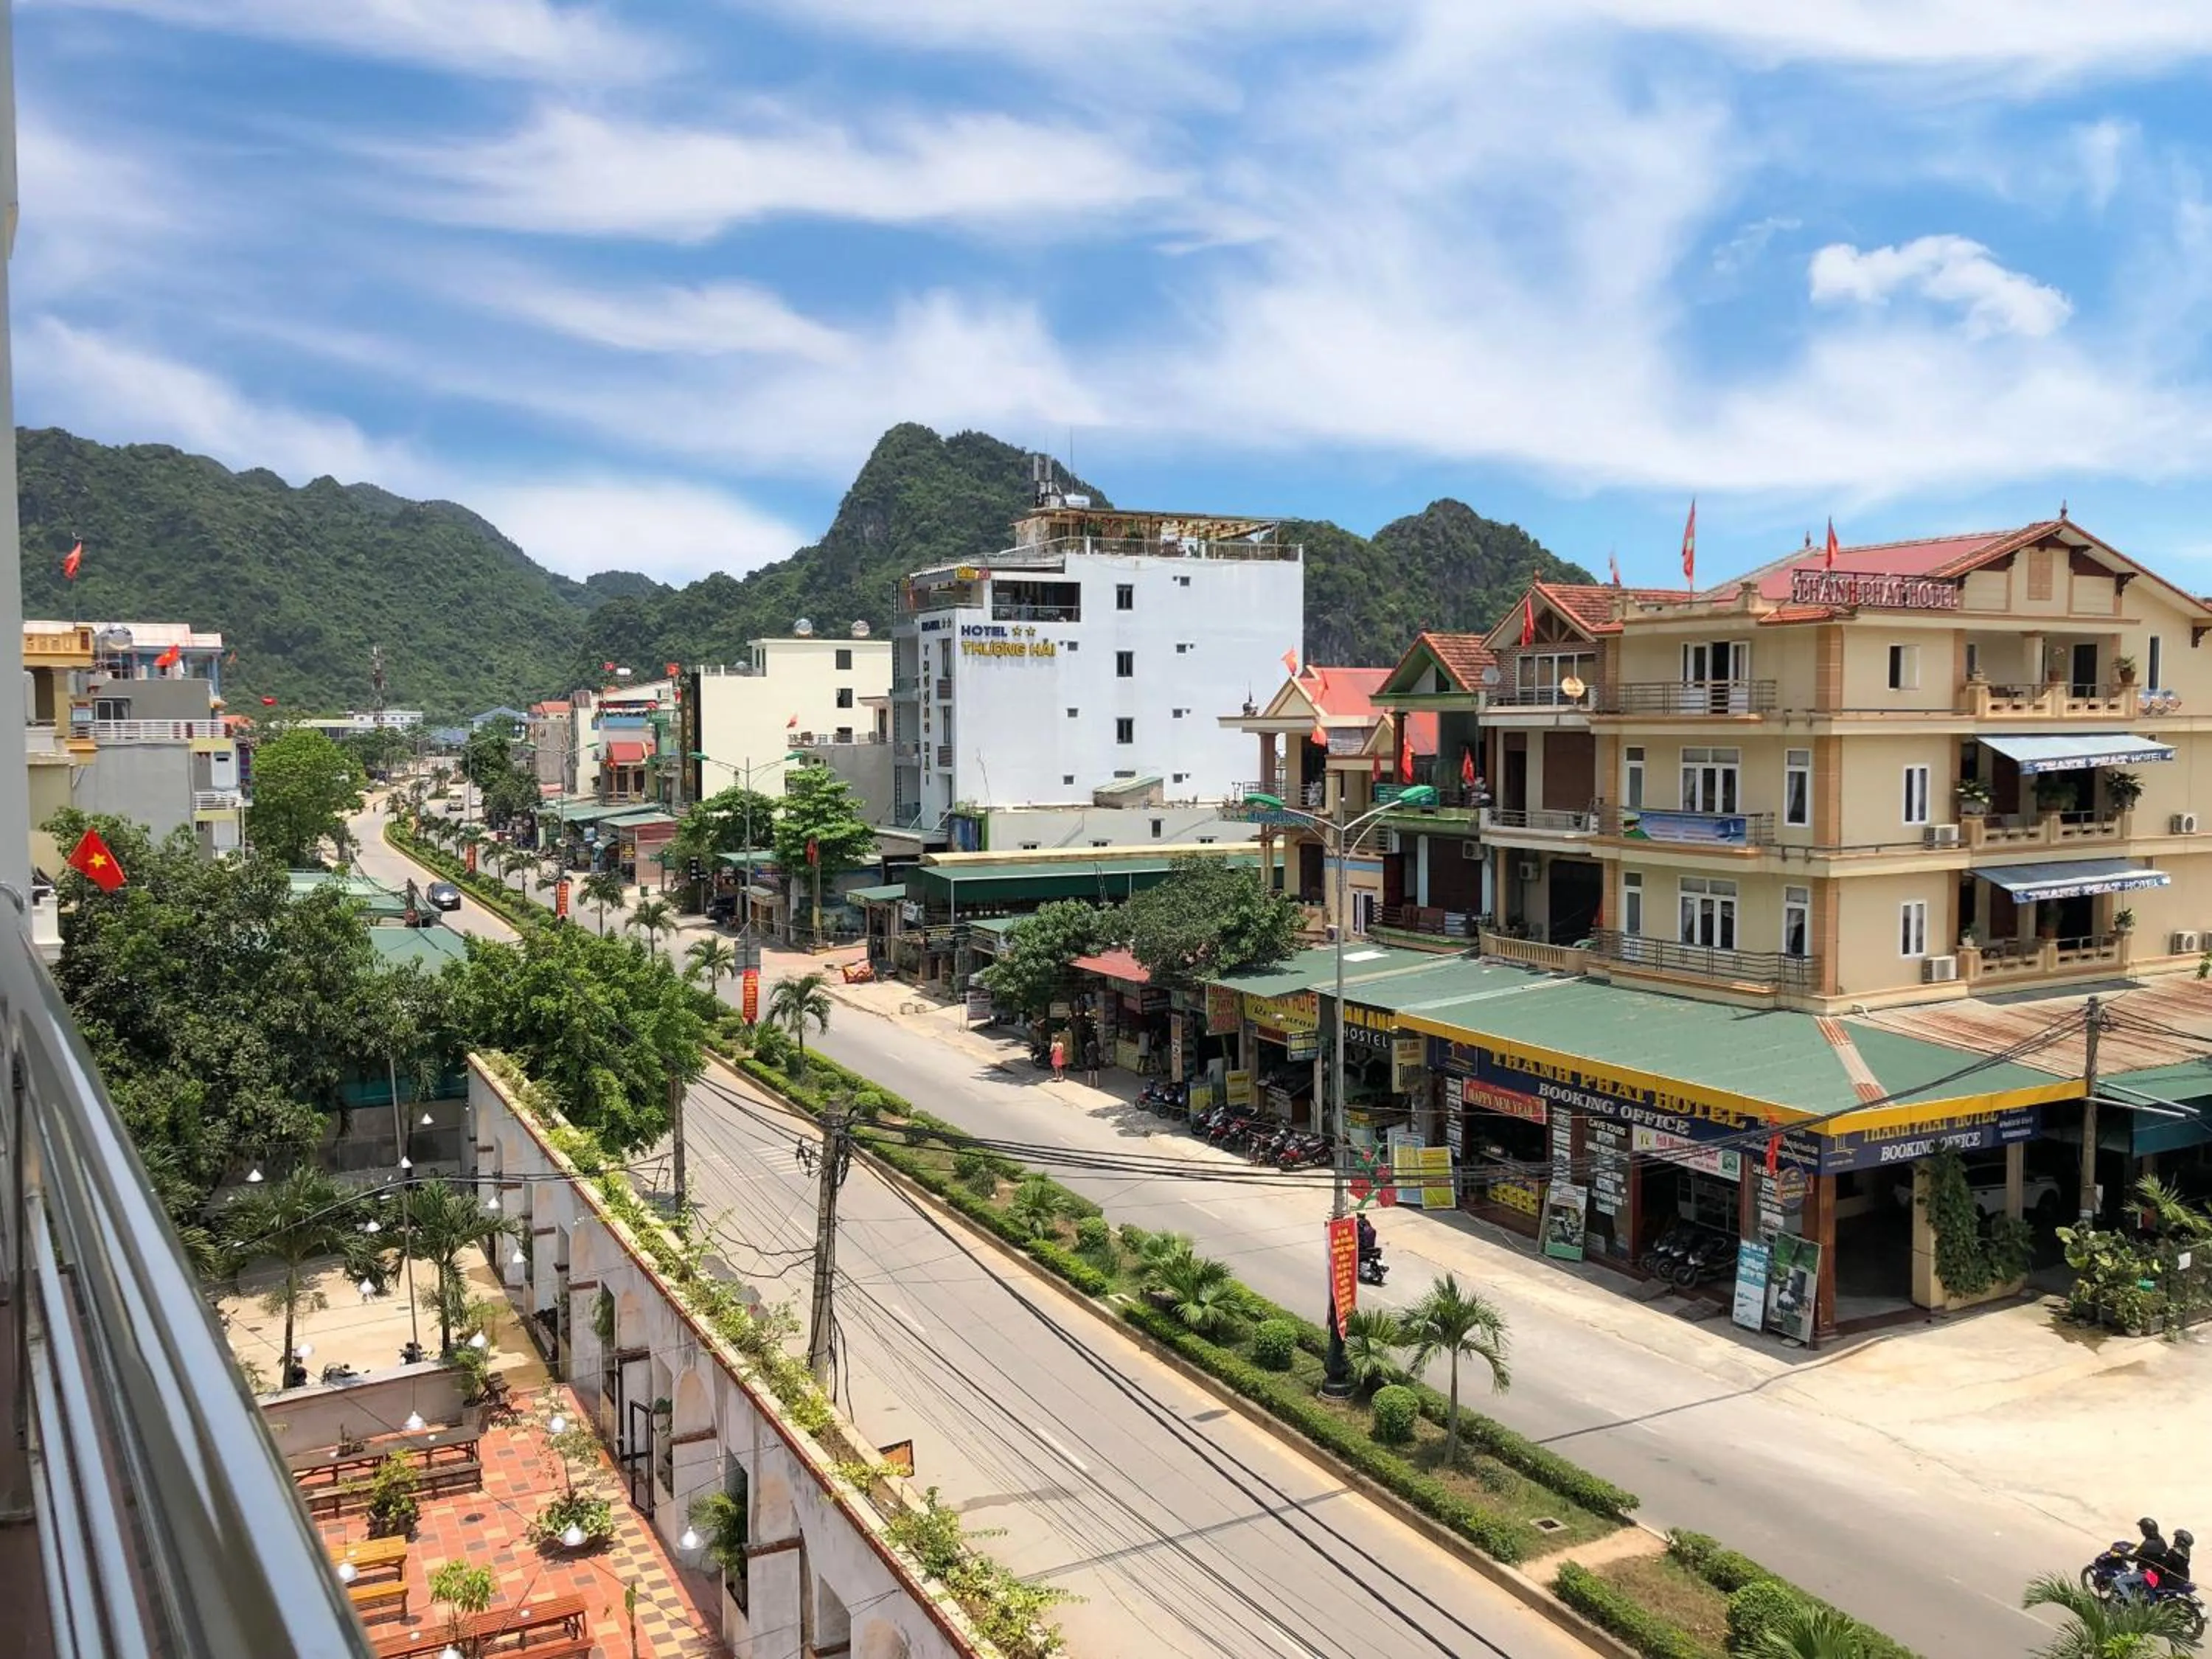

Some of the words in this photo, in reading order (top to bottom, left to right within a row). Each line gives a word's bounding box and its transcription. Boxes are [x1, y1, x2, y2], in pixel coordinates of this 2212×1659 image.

[1906, 581, 1958, 609] HOTEL
[961, 625, 1007, 636] HOTEL
[2132, 752, 2162, 763] HOTEL
[1468, 1088, 1492, 1107] HAPPY
[1491, 1050, 1573, 1085] THANH
[1580, 1072, 1646, 1105] PHAT
[1653, 1092, 1747, 1130] HOTEL
[1538, 1082, 1615, 1115] BOOKING
[1620, 1105, 1691, 1136] OFFICE
[1880, 1139, 1935, 1163] BOOKING
